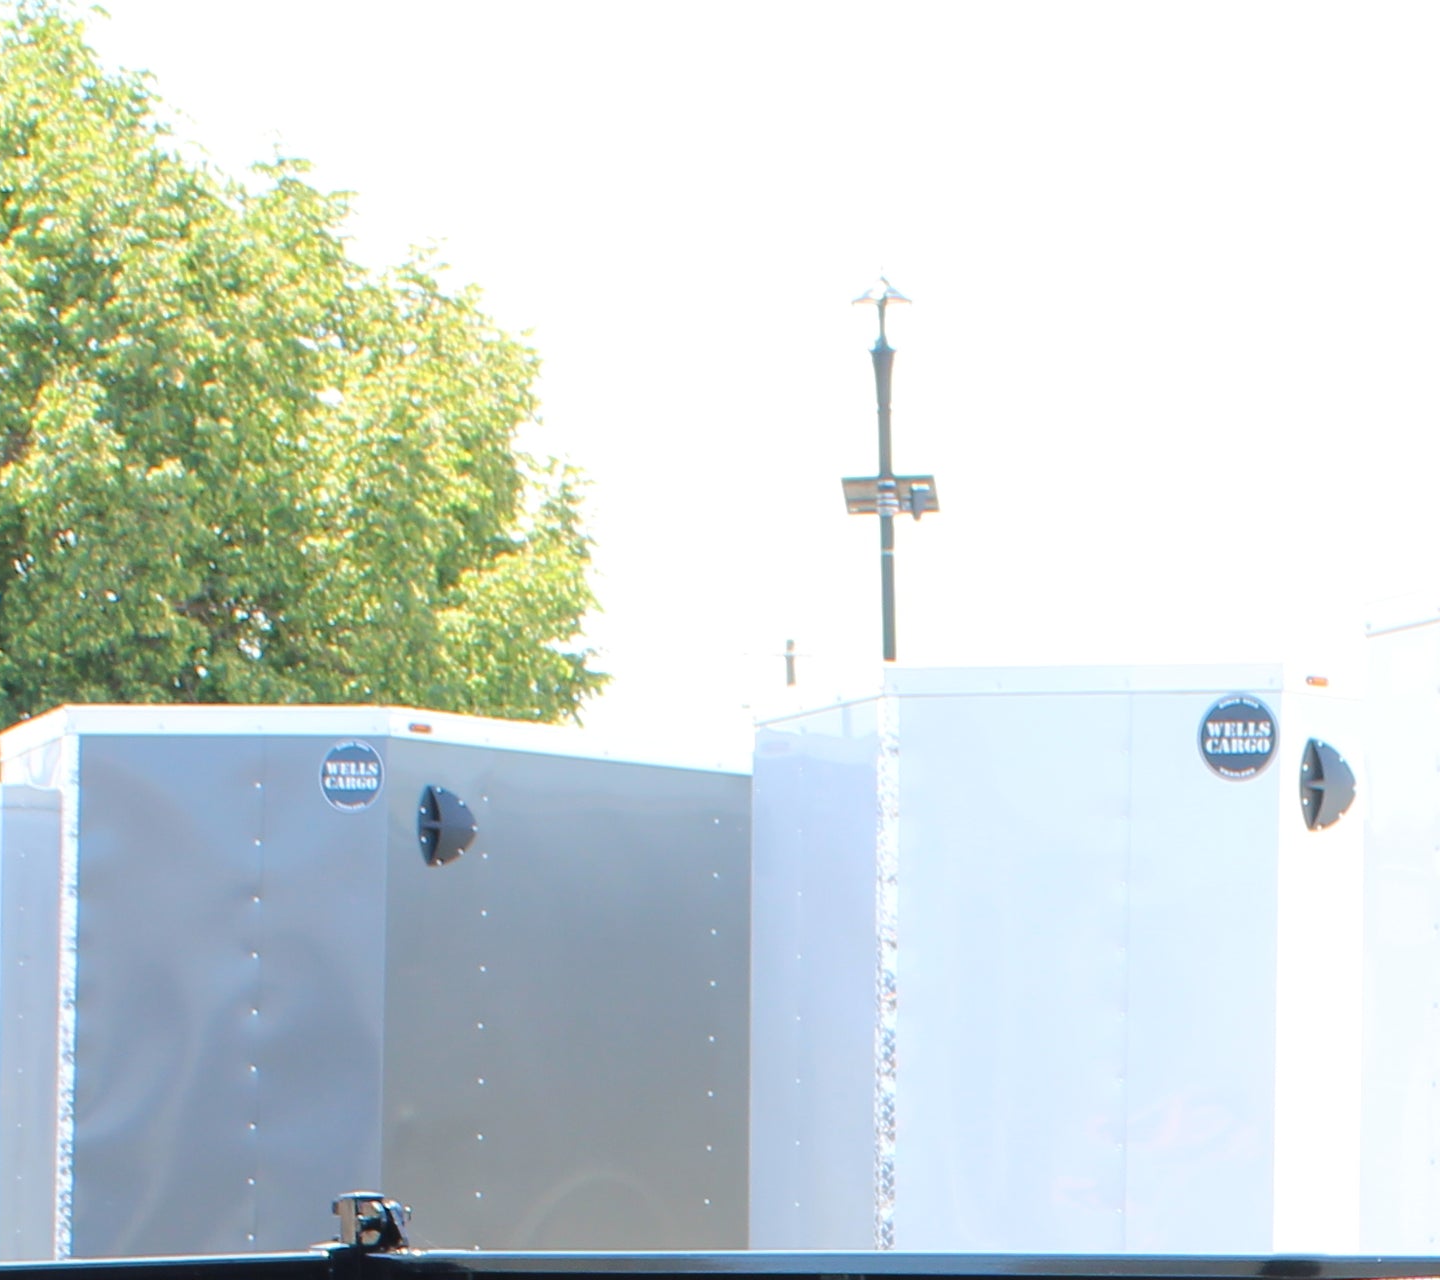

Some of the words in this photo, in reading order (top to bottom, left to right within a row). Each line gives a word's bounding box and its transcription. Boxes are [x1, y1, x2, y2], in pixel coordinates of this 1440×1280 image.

[1206, 720, 1271, 738] WELLS
[1205, 738, 1271, 754] CARGO
[326, 761, 379, 776] WELLS
[324, 776, 378, 790] CARGO
